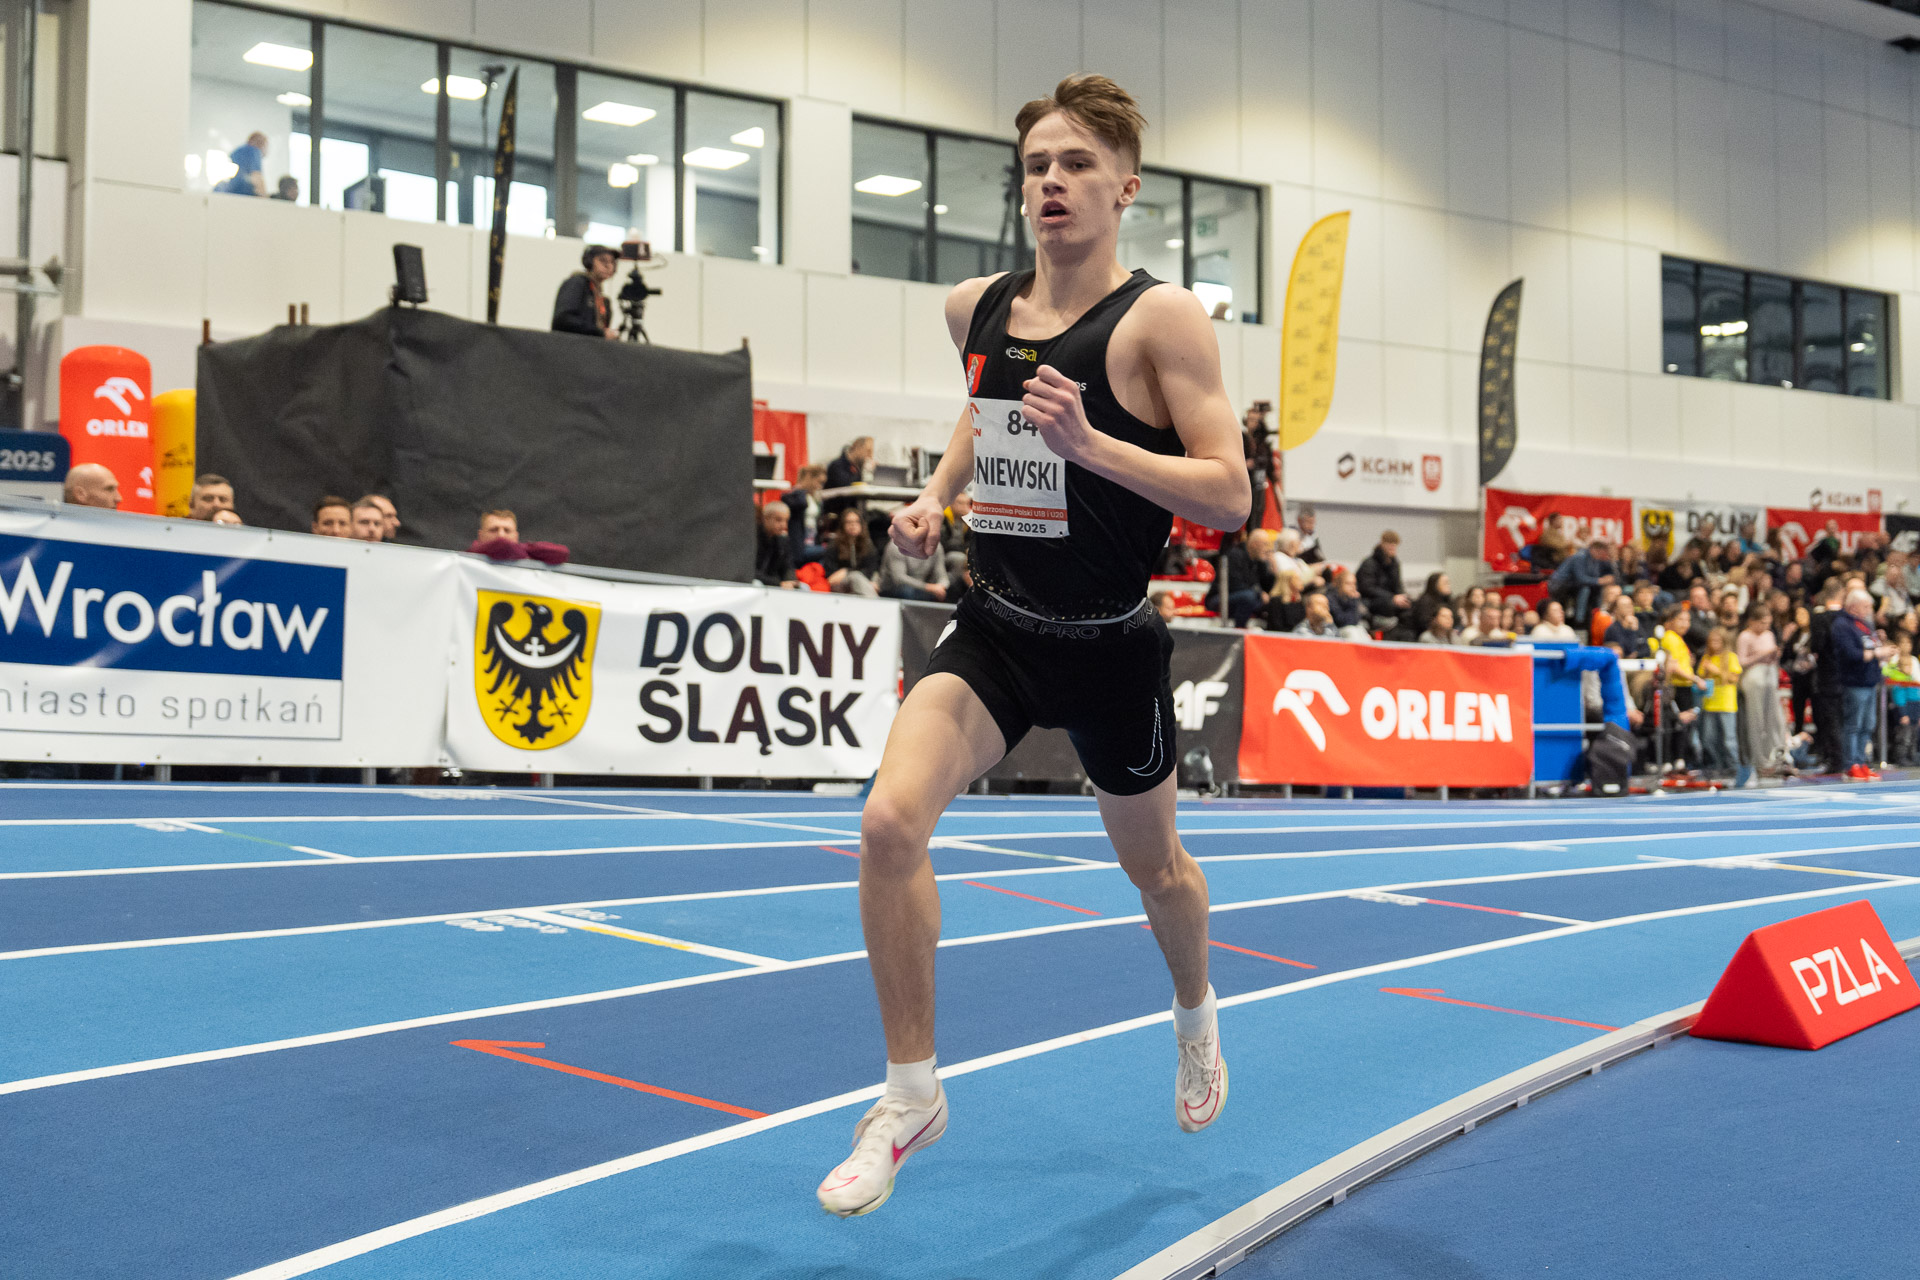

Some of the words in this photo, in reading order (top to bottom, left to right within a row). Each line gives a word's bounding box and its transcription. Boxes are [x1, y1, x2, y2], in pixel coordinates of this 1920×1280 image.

[86, 419, 149, 439] ORLEN
[0, 449, 56, 472] 2025
[974, 455, 1058, 492] NIEWSKI
[1014, 508, 1033, 518] Polski
[1017, 522, 1047, 534] 2025
[0, 555, 330, 655] Wrocław
[984, 596, 1039, 632] NIKE
[1038, 622, 1101, 639] PRO
[638, 610, 881, 681] DOLNY
[161, 687, 324, 730] spotkań
[636, 666, 864, 756] ŚLĄSK
[1360, 686, 1514, 743] ORLEN
[1789, 937, 1901, 1016] PZLA
